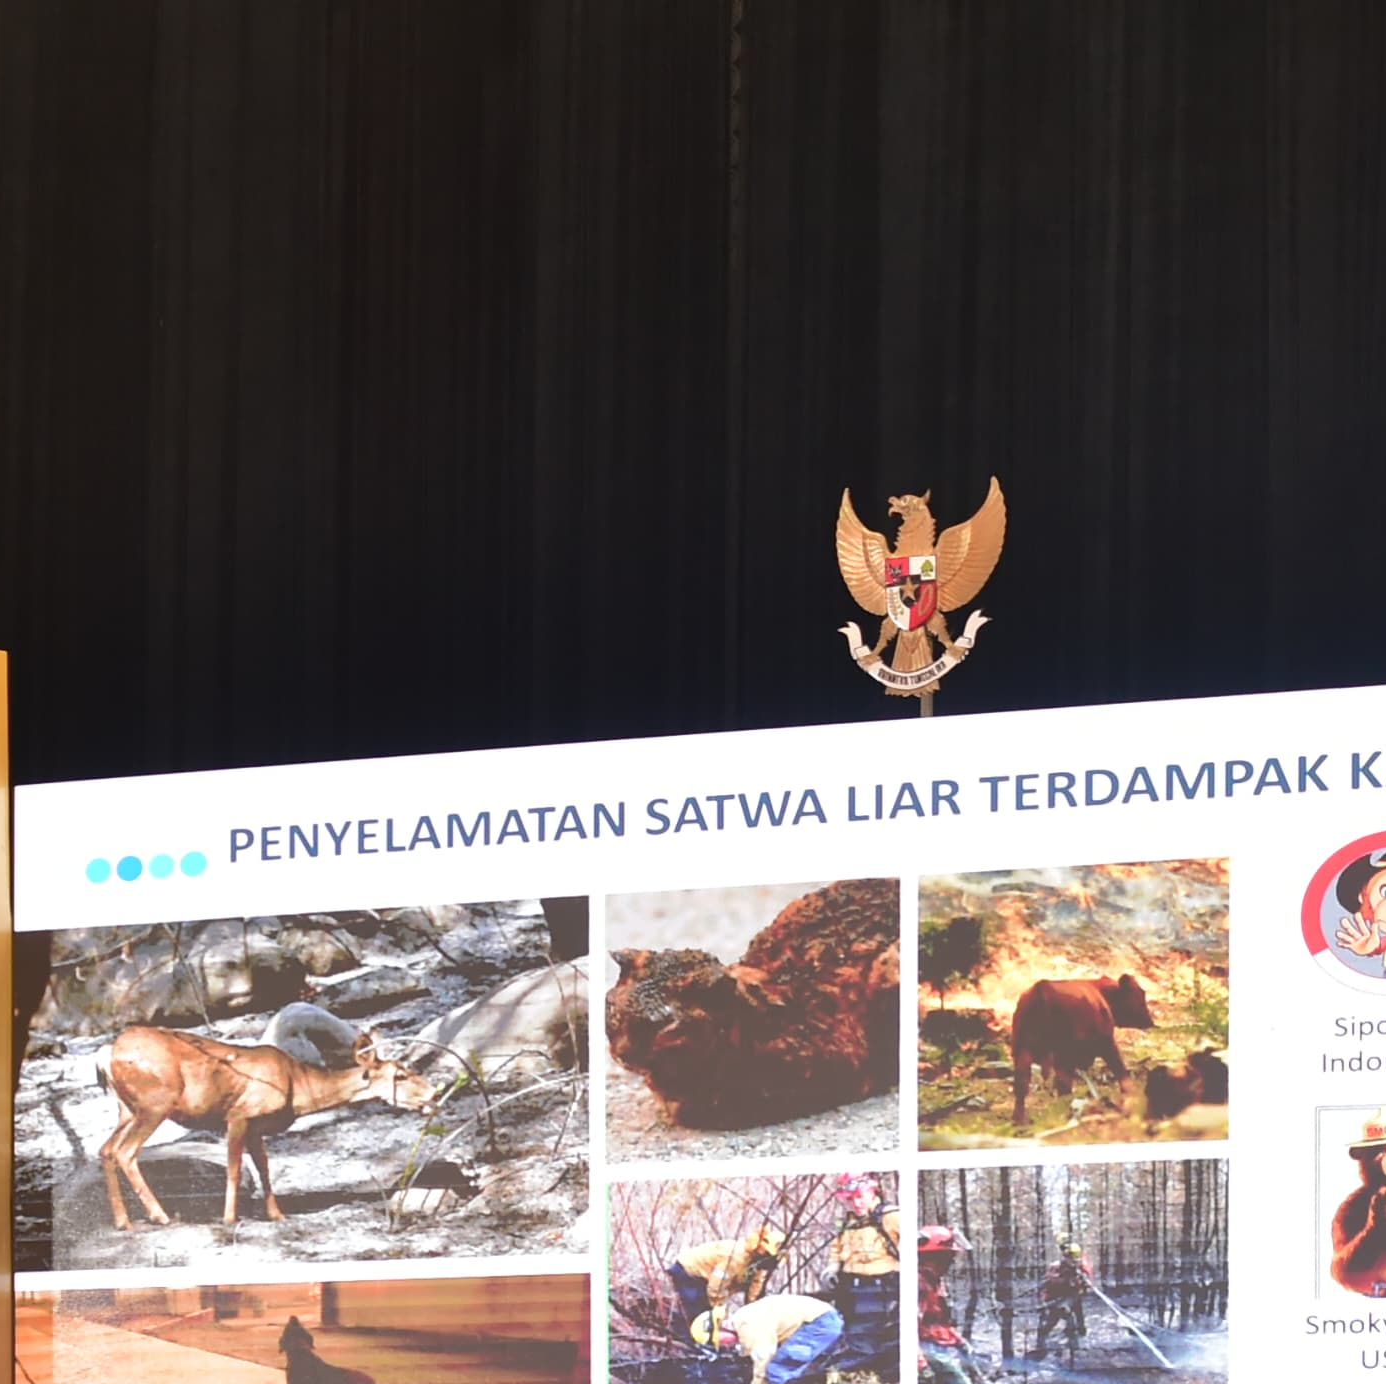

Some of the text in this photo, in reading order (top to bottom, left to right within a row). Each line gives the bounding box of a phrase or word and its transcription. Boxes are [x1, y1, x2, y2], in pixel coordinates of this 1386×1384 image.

[231, 801, 624, 863] PENYELAMATAN
[646, 786, 827, 836] SATWA
[847, 778, 961, 822] LIAR
[979, 754, 1328, 812] TERDAMPAK
